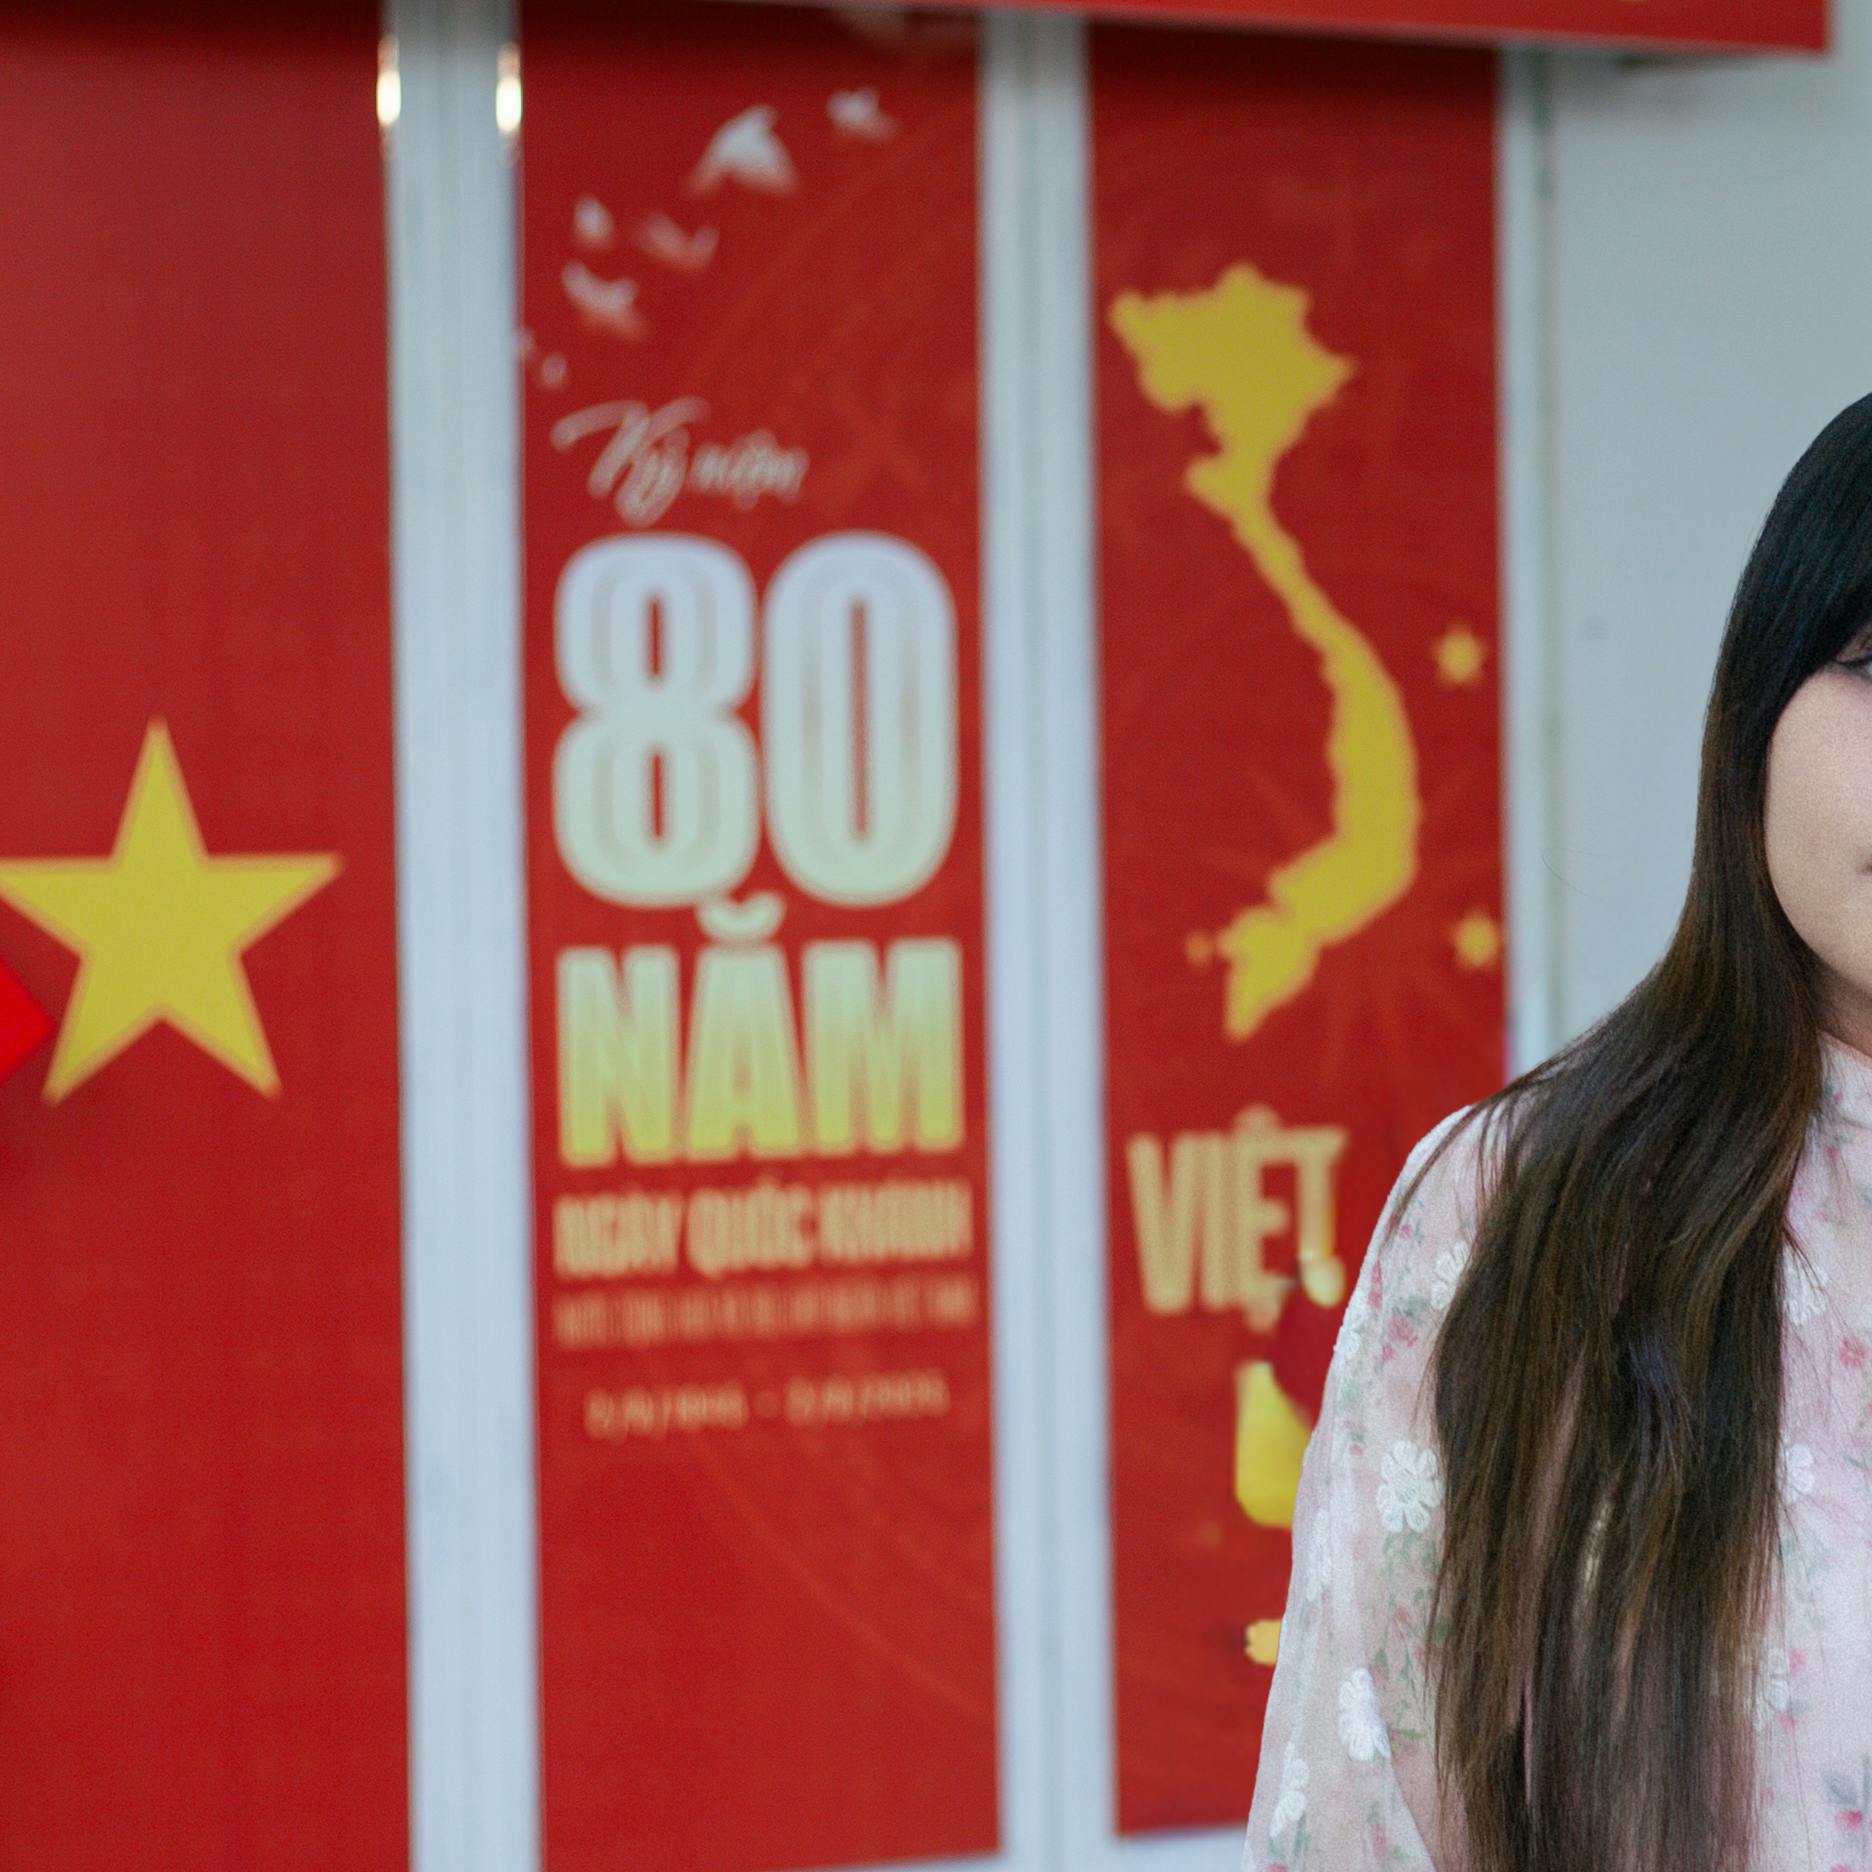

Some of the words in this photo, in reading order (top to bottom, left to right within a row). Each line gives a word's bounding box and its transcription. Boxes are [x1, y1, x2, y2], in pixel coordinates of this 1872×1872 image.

[551, 527, 962, 911] 80
[554, 890, 964, 1168] NĂM
[1125, 1102, 1349, 1331] VIỆT
